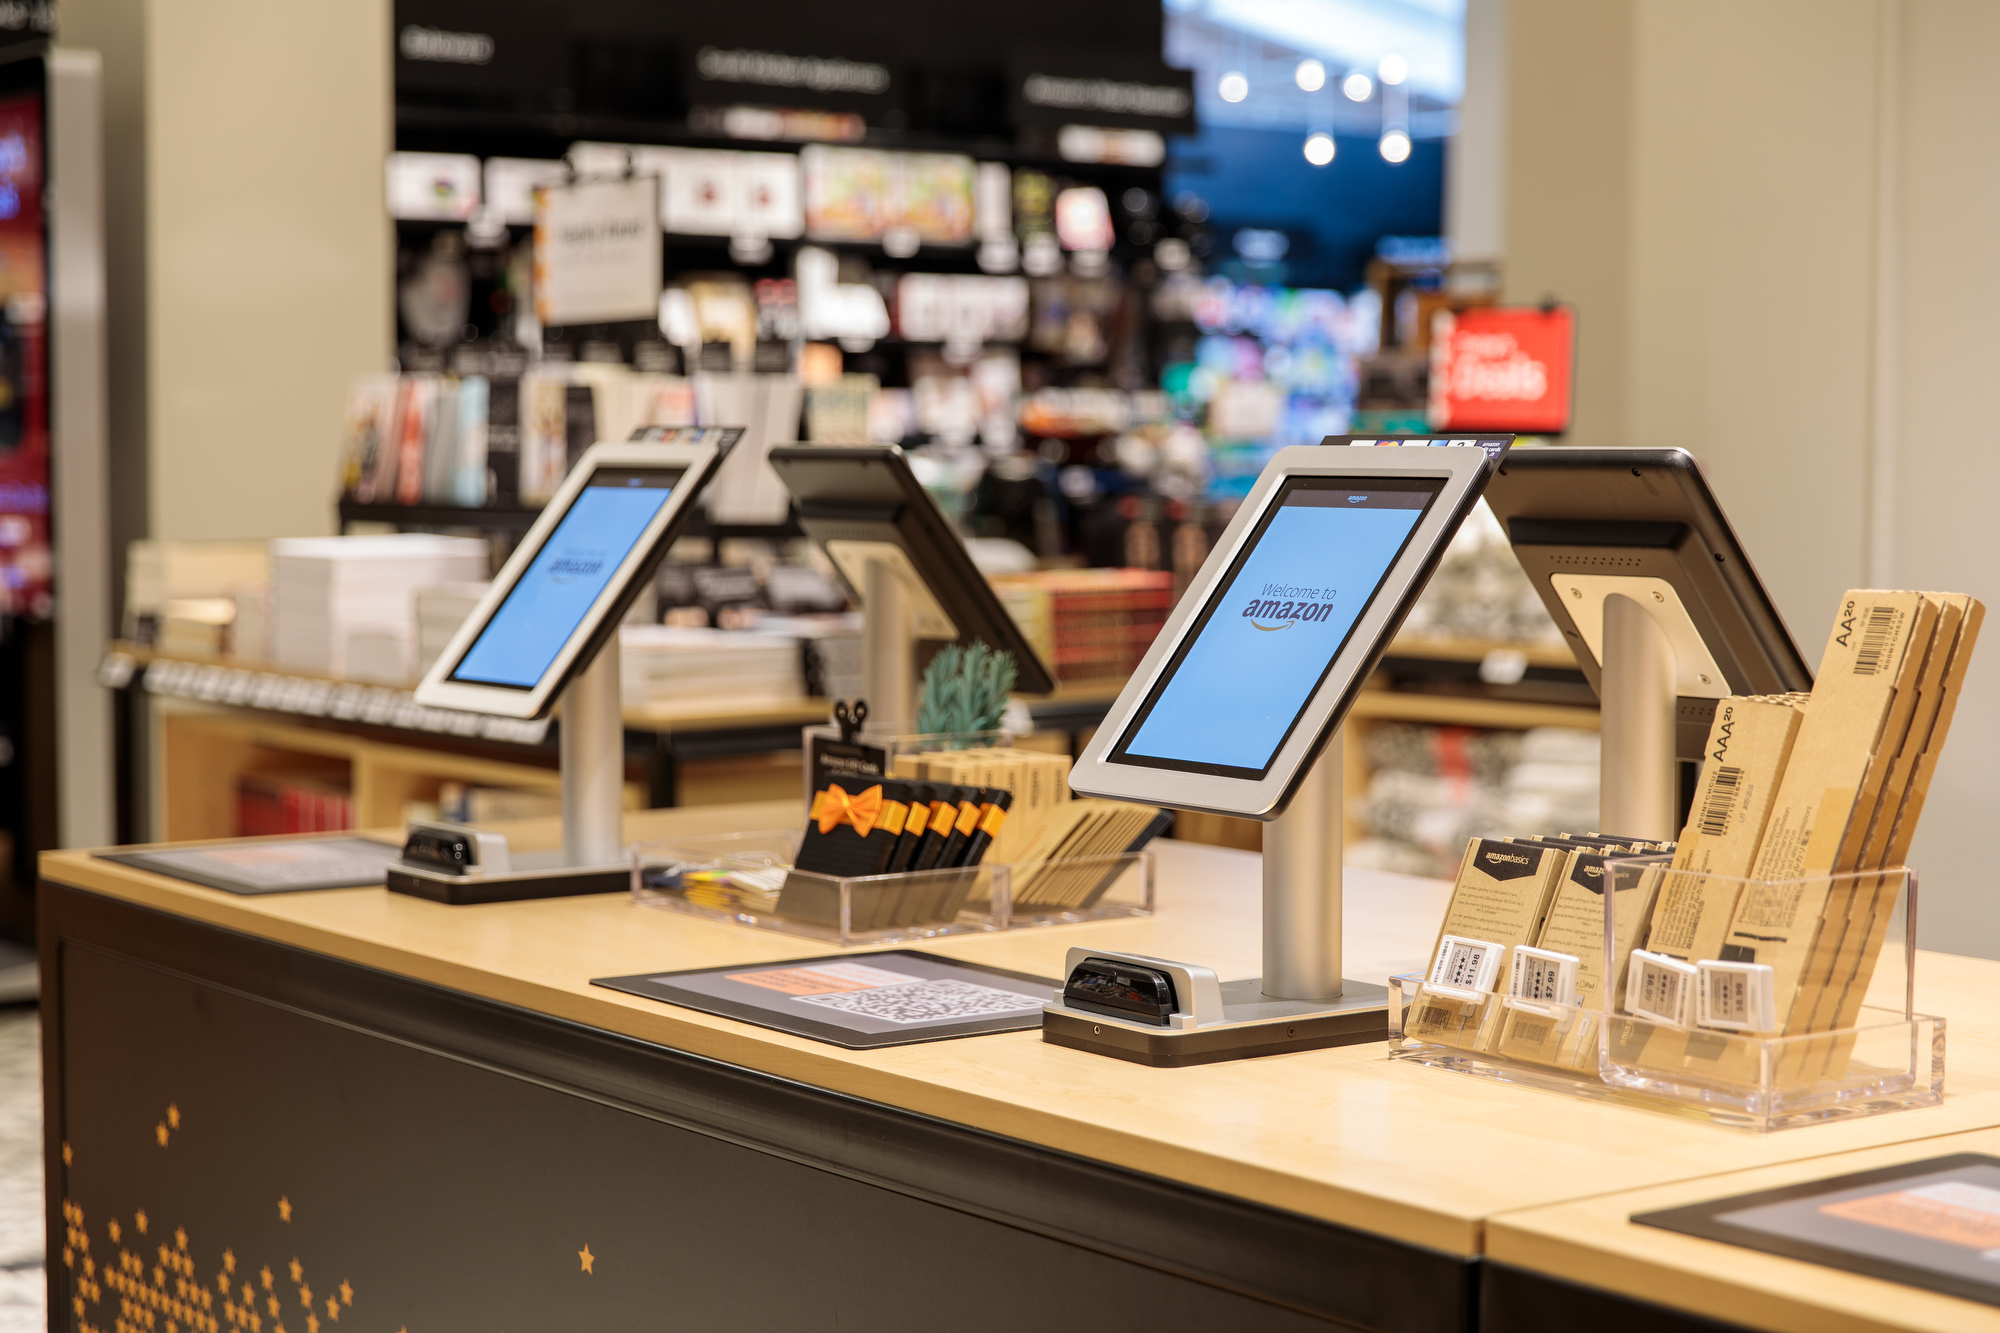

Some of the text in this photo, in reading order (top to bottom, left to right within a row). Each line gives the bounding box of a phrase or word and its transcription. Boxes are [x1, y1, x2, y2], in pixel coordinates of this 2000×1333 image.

[1262, 584, 1337, 600] Welcome to
[1242, 599, 1334, 622] amazon
[1485, 851, 1530, 865] amazonbasics
[1465, 953, 1480, 986] $11.98
[1546, 970, 1556, 999] $7.99
